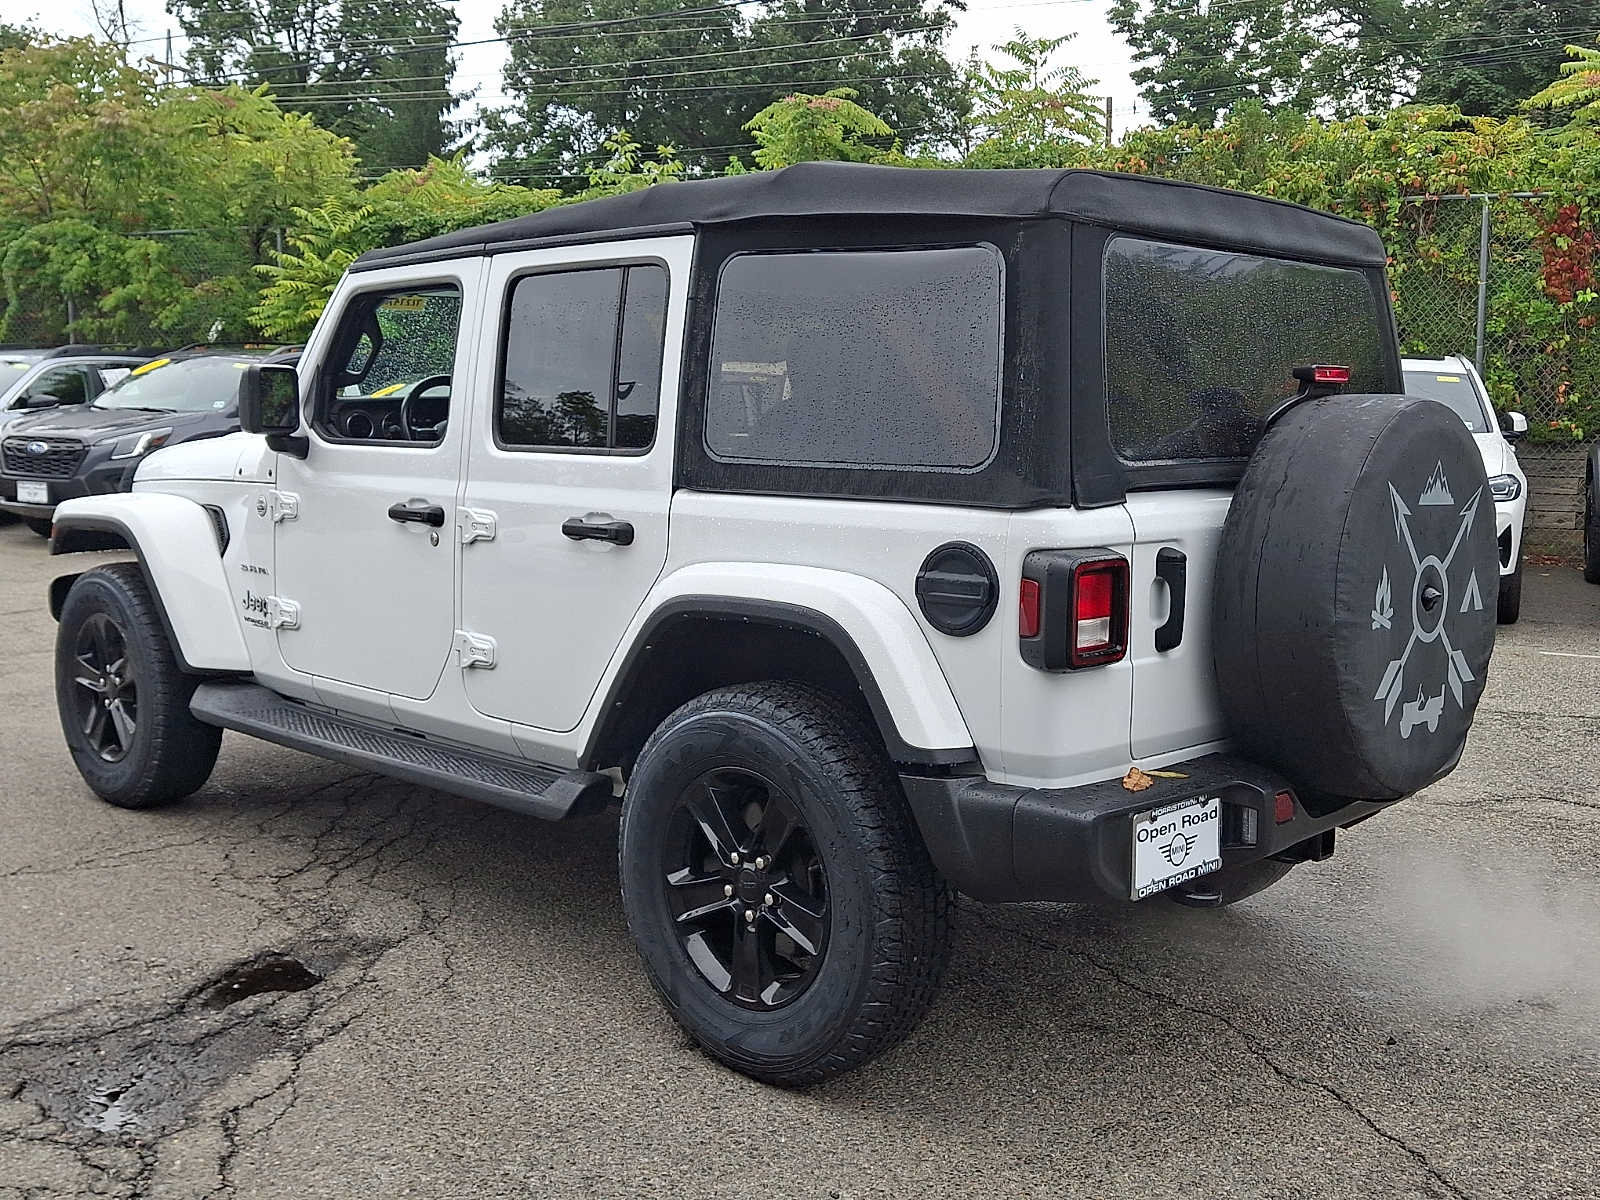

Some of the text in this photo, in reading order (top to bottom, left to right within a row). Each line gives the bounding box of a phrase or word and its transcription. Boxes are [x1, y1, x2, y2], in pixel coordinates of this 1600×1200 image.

[1137, 806, 1218, 843] Open Road
[1138, 860, 1219, 899] OPEN ROAD MINI
